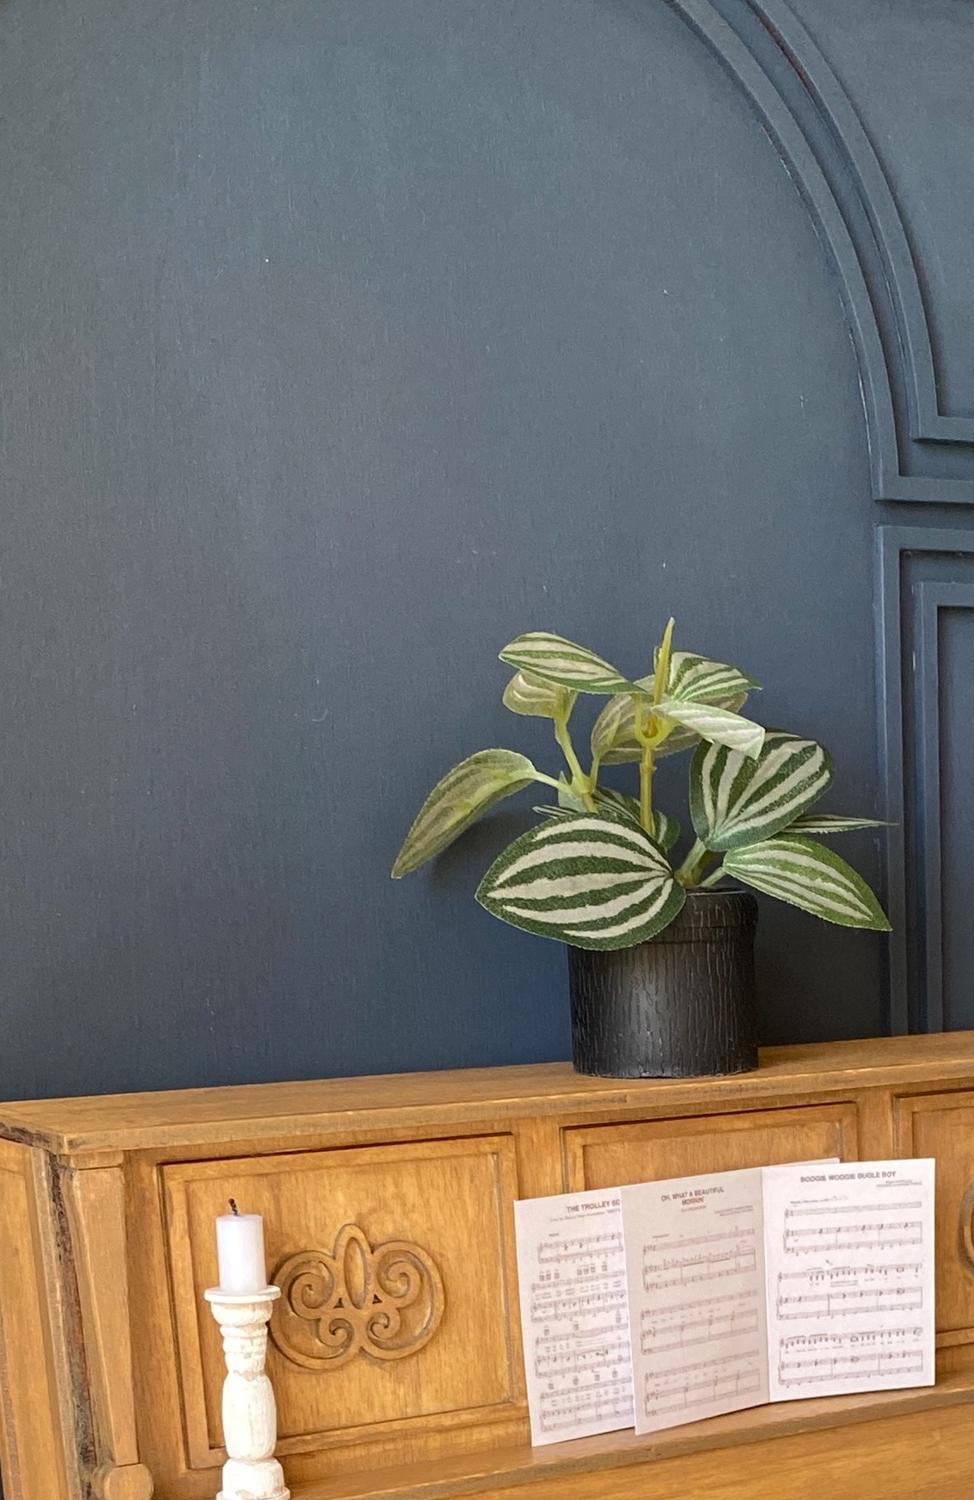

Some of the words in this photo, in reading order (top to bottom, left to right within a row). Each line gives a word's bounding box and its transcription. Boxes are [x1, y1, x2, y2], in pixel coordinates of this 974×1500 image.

[800, 1175, 826, 1183] BOOGIE
[828, 1173, 856, 1181] WOOGIE
[857, 1171, 880, 1180] BUGLE
[566, 1204, 580, 1213] THE
[581, 1200, 610, 1211] TROLLEY
